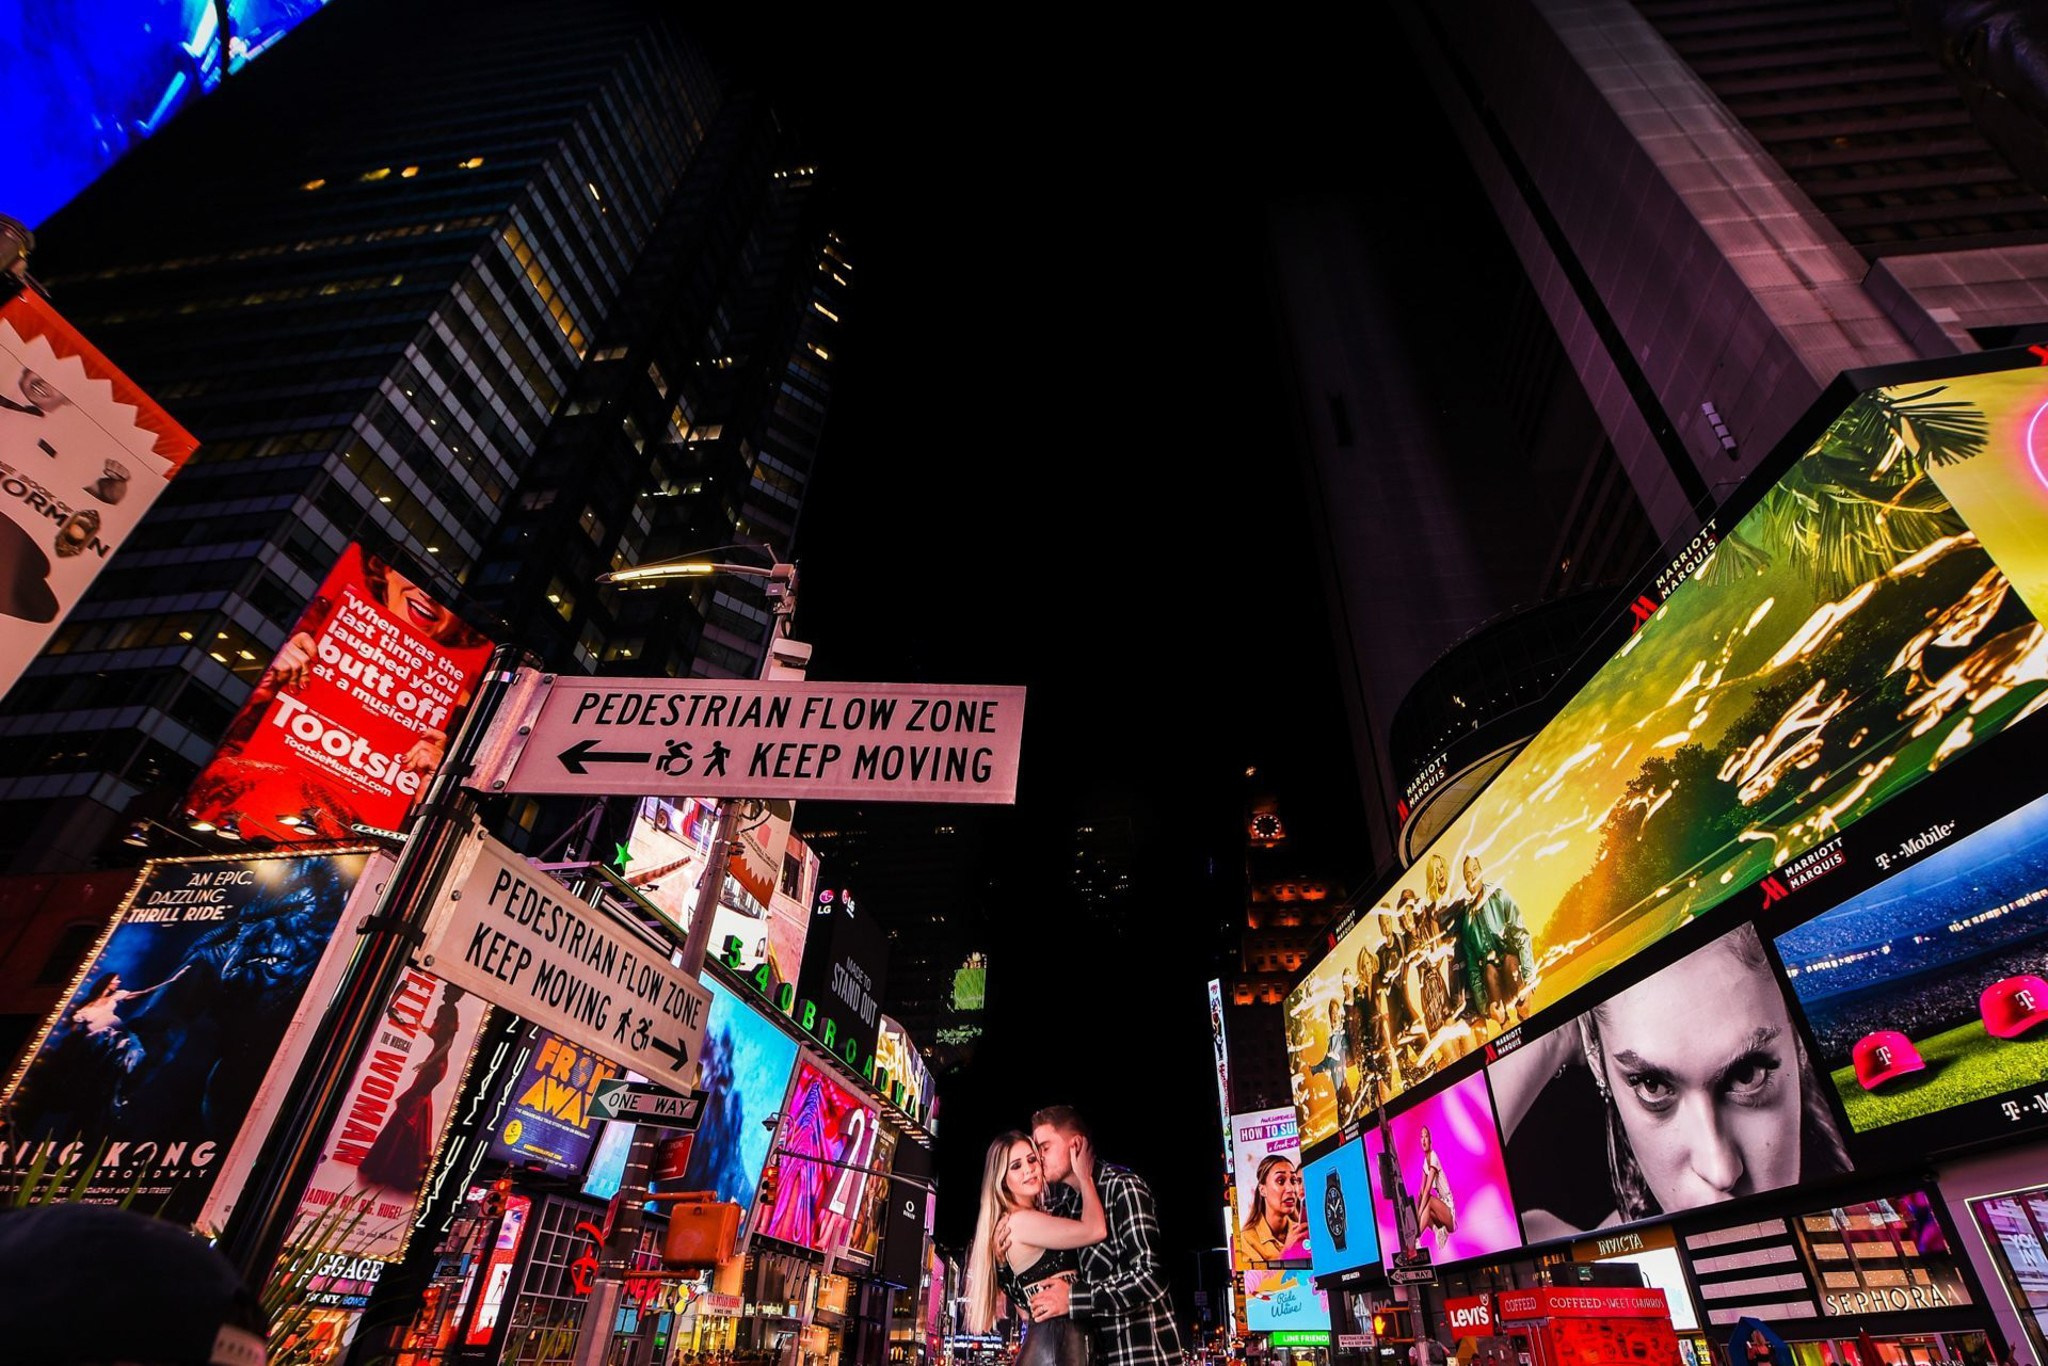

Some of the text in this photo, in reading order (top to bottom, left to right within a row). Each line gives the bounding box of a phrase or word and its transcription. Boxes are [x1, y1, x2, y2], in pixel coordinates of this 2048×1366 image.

[1656, 518, 1717, 588] MARRIOTT
[1661, 538, 1717, 600] MARQUIS
[327, 620, 454, 704] laughed your
[336, 605, 460, 694] last time you
[403, 633, 436, 661] was
[438, 656, 465, 681] the
[312, 664, 335, 682] at
[336, 678, 350, 691] a
[318, 634, 395, 698] butt
[396, 690, 448, 727] off
[571, 692, 999, 733] PEDESTRIAN FLOW ZONE
[272, 691, 421, 796] Tootsie
[747, 742, 994, 784] KEEP MOVING
[284, 733, 392, 797] TootsieMusical.com
[1407, 752, 1447, 797] MARRIOTT
[1409, 769, 1445, 808] MARQUIS
[1785, 837, 1843, 878] MARRIOTT
[1790, 853, 1844, 889] MARQUIS
[147, 888, 227, 905] DAZZLING
[187, 872, 214, 887] AN
[127, 907, 182, 923] THRILL
[817, 904, 832, 915] LG
[487, 867, 702, 1031] PEDESTRIAN FLOW ZONE
[465, 921, 611, 1032] KEEP MOVING
[846, 956, 872, 991] MADE TO
[388, 969, 437, 1040] ETTY
[832, 962, 878, 1029] STAND OUT
[332, 1050, 407, 1167] WOMAN
[608, 1092, 691, 1117] ONE WAY
[1240, 1127, 1263, 1141] HOW
[1266, 1126, 1279, 1138] TO
[377, 1202, 403, 1220] HUGE!
[1597, 1233, 1644, 1256] INVICTA
[1394, 1270, 1430, 1280] ONE WAY
[1277, 1291, 1296, 1305] Ride
[1505, 1296, 1537, 1312] COFFEED
[1550, 1296, 1602, 1310] COFFEED
[1606, 1298, 1630, 1309] SWEET
[1631, 1297, 1665, 1309] CHURROS
[1826, 1284, 1951, 1316] SEPHORA
